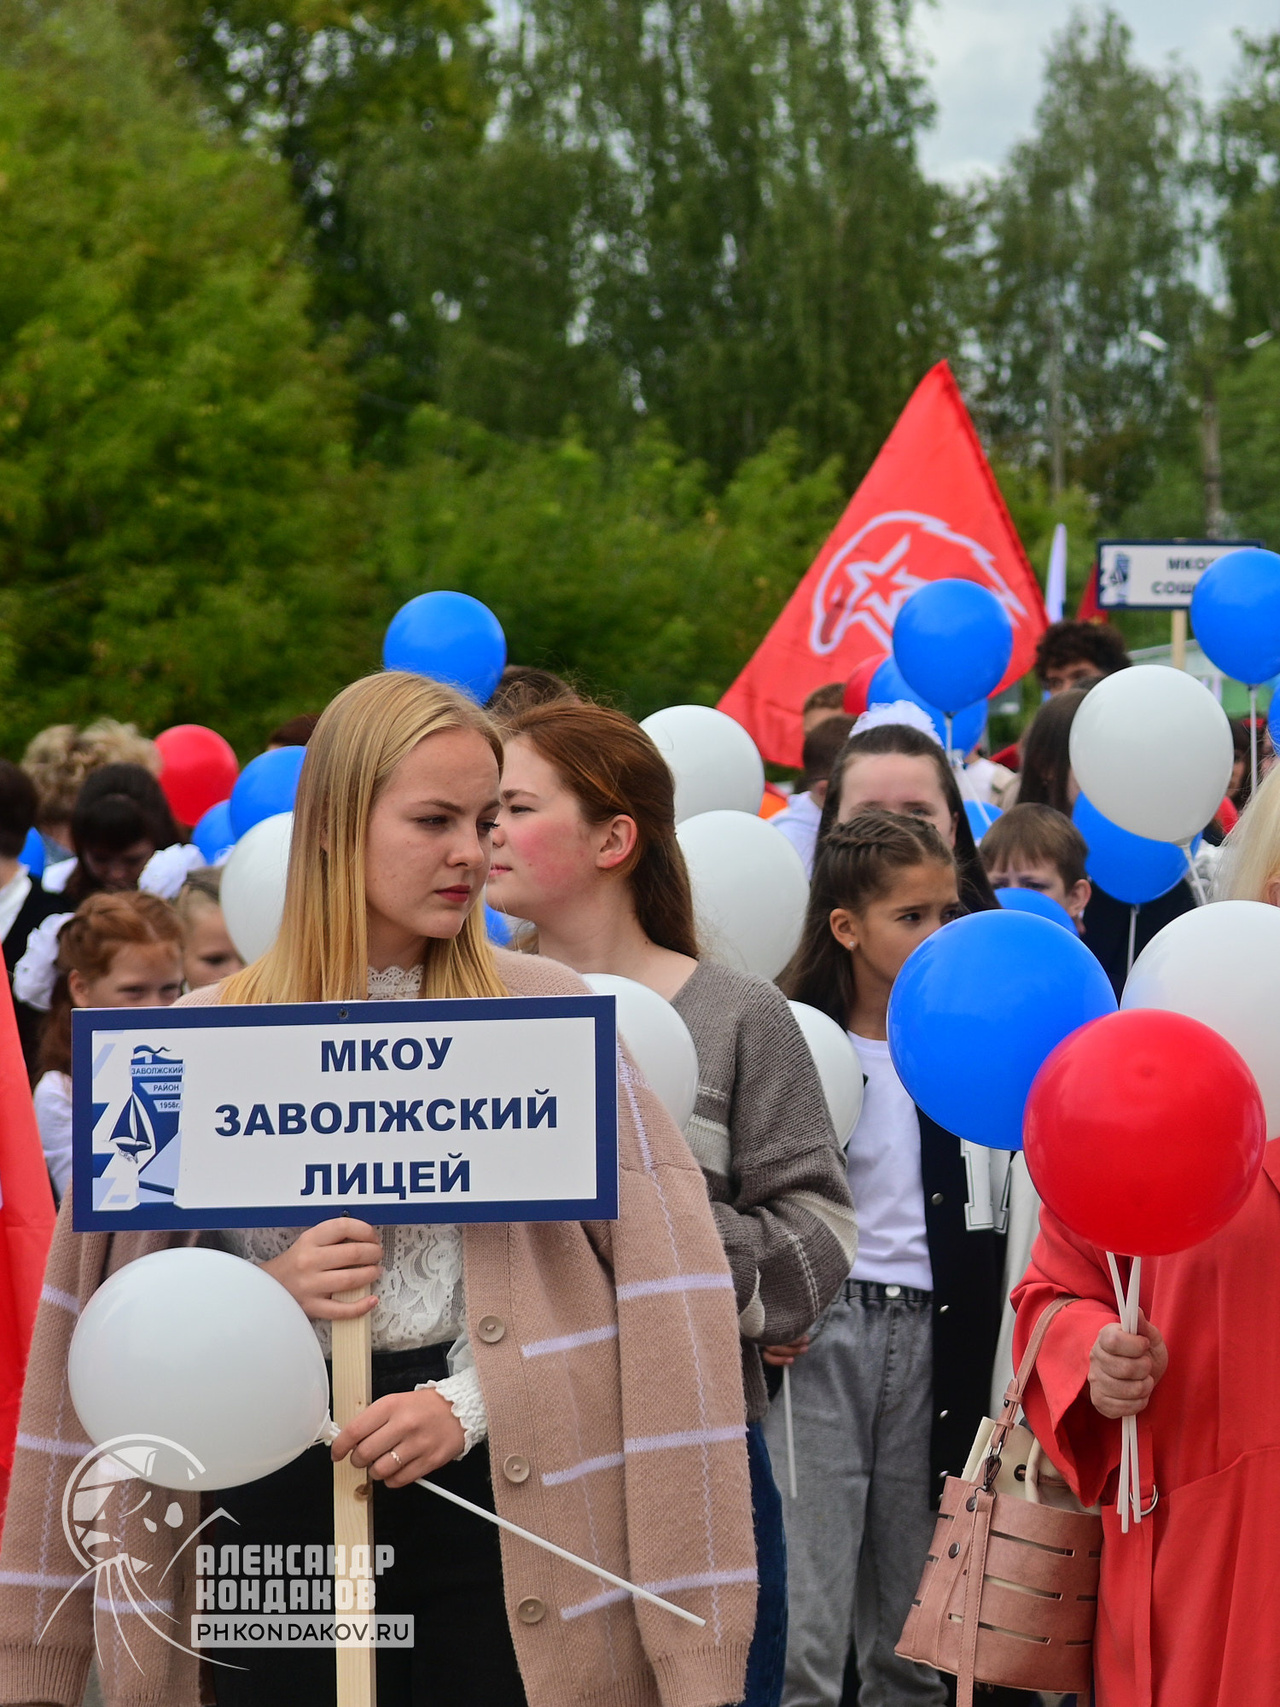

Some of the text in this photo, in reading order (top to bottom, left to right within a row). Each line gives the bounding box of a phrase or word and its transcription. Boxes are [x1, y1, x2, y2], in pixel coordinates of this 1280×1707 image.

[131, 1065, 183, 1075] ЗАВОЛЖСКИЙ
[321, 1036, 453, 1072] МКОУ
[153, 1083, 179, 1092] РАЙОН
[214, 1088, 558, 1136] ЗАВОЛЖСКИЙ
[300, 1153, 470, 1200] ЛИЦЕЙ
